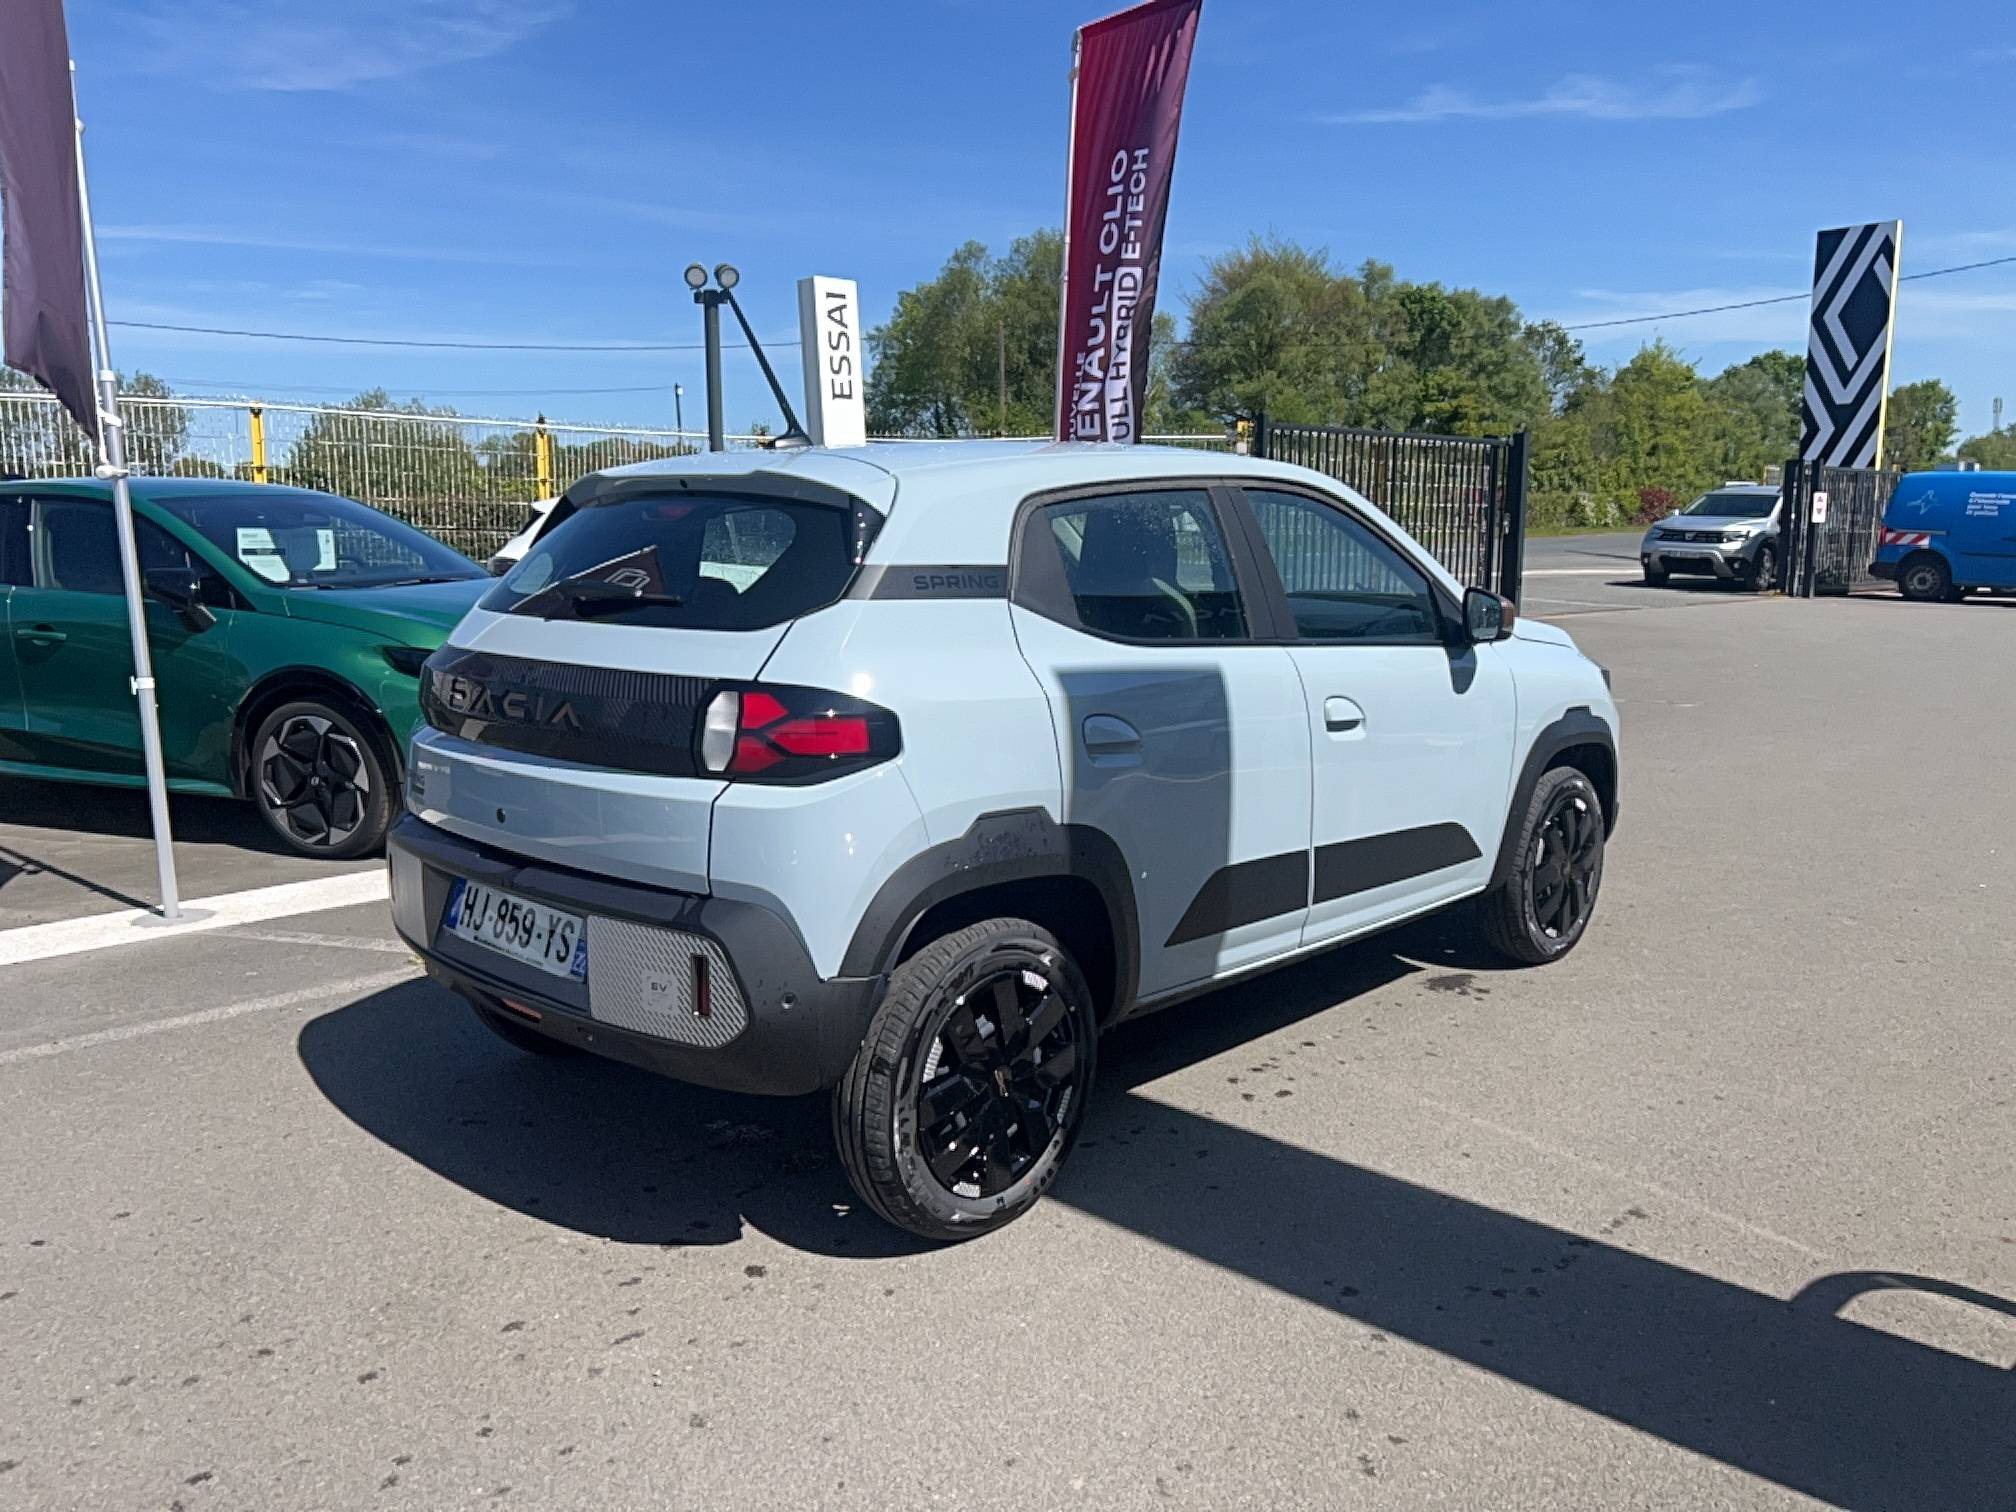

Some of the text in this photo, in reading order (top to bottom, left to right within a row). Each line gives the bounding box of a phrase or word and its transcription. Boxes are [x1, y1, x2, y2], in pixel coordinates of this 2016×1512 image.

[1077, 149, 1127, 437] ENAULT CLIO
[1109, 148, 1149, 440] ULL HYBRID E-TECH
[826, 291, 853, 400] ESSAI
[912, 574, 999, 591] SPRING
[459, 886, 576, 963] HJ-859-YS
[651, 982, 668, 993] EV
